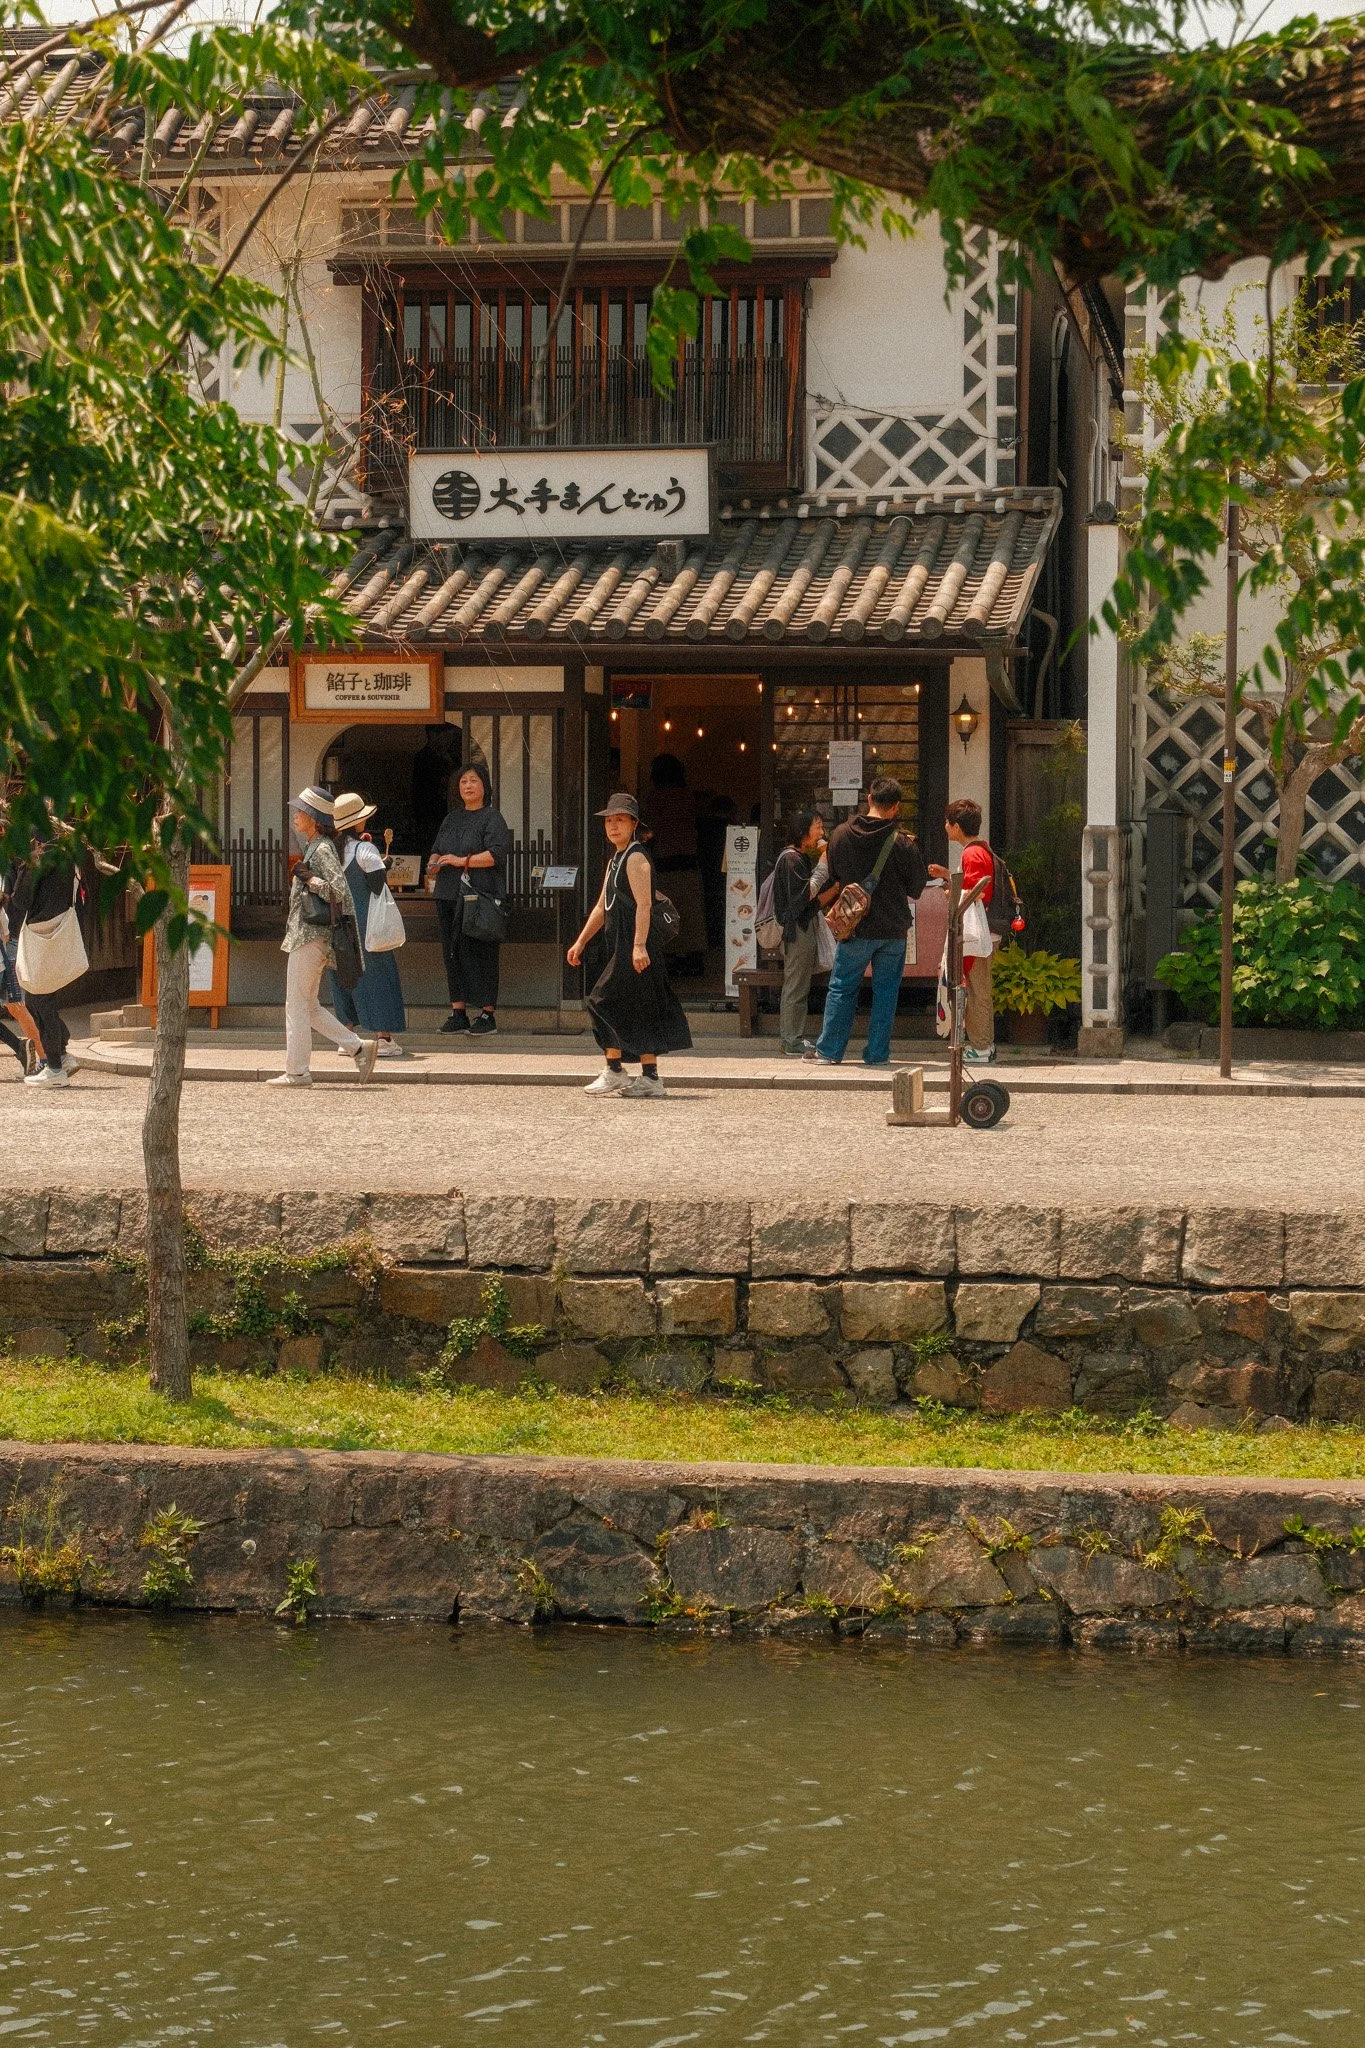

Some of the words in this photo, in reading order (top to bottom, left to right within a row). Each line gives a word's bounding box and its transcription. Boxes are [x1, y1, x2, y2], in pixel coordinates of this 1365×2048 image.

[326, 672, 412, 692] 餡子と珈琲
